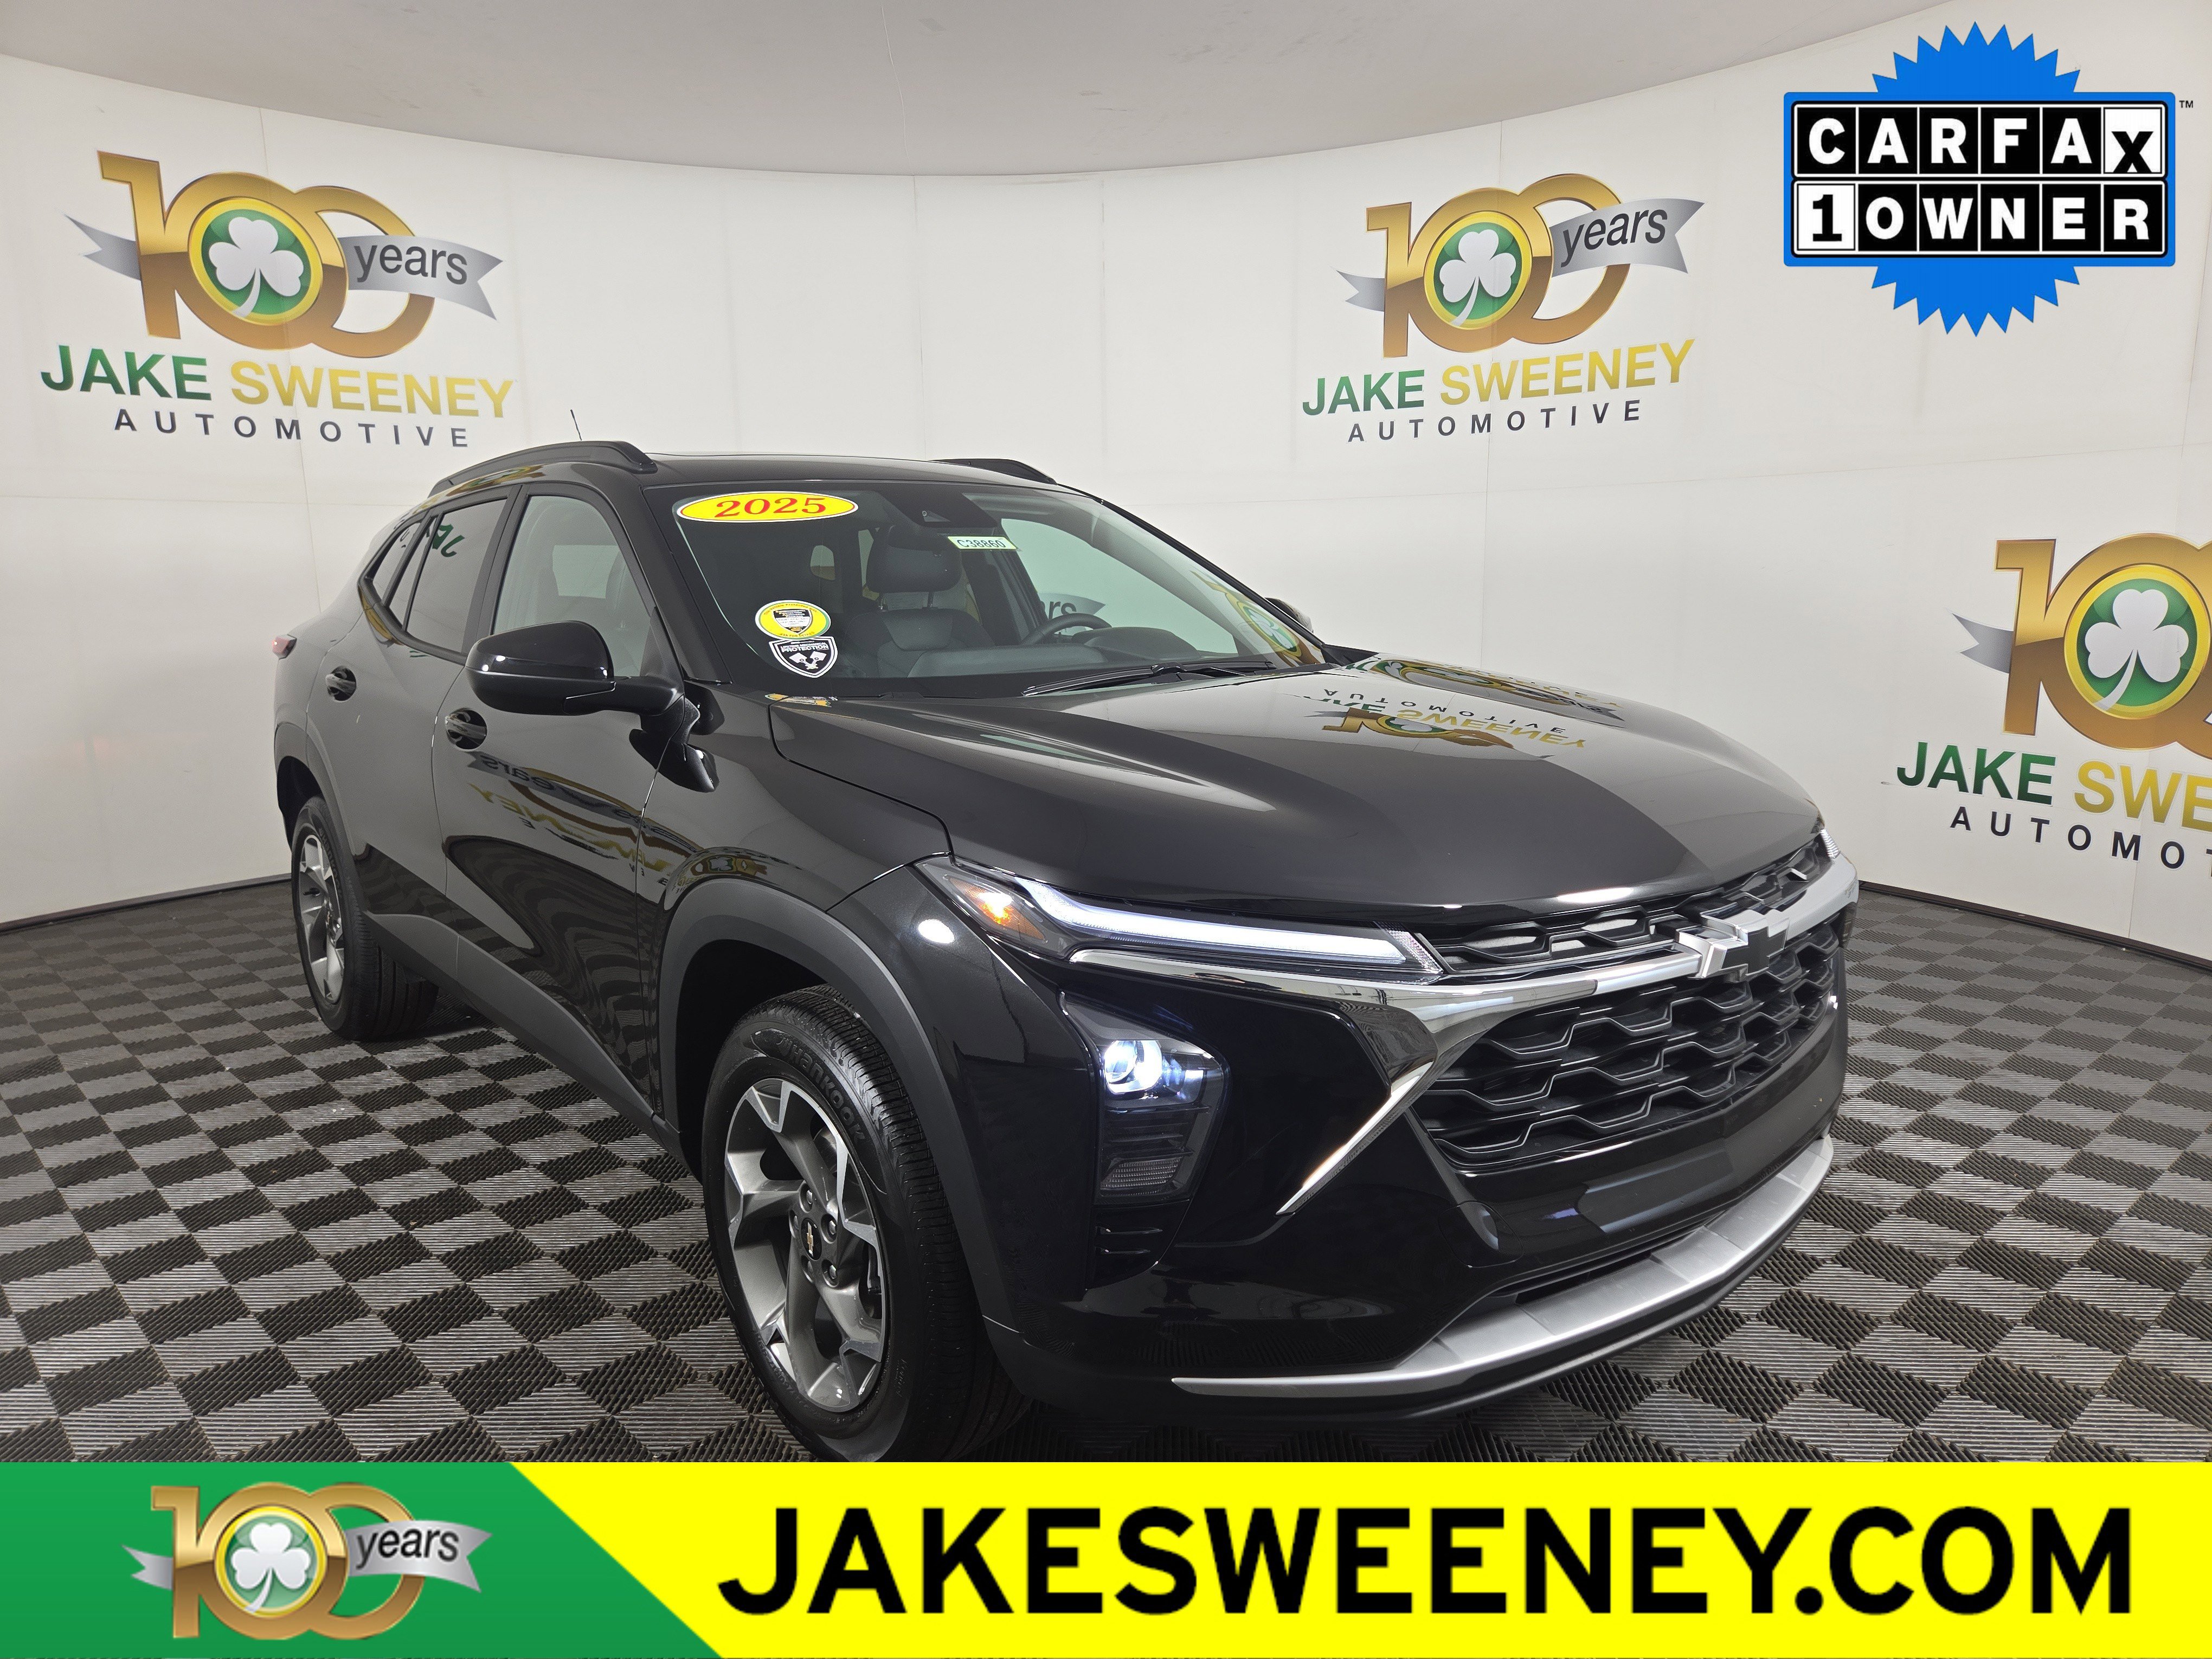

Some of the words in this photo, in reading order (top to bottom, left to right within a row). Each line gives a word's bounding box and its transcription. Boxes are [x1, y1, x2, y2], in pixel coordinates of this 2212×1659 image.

[97, 151, 435, 358] 100
[353, 244, 468, 285] years
[1366, 173, 1631, 358] 100
[1560, 209, 1668, 267] years
[41, 344, 212, 401] JAKE
[230, 361, 513, 418] SWEENEY
[1302, 369, 1425, 416] JAKE
[1440, 339, 1695, 406] SWEENEY
[114, 408, 468, 448] AUTOMOTIVE
[1348, 399, 1641, 443] AUTOMOTIVE
[714, 497, 827, 519] 2025
[957, 539, 1006, 548] C38860
[781, 644, 829, 653] PROTECTION
[1994, 532, 2212, 760] 10
[1896, 741, 2056, 805] JAKE
[2074, 761, 2212, 833] SWE
[1950, 806, 2212, 877] AUTOMO
